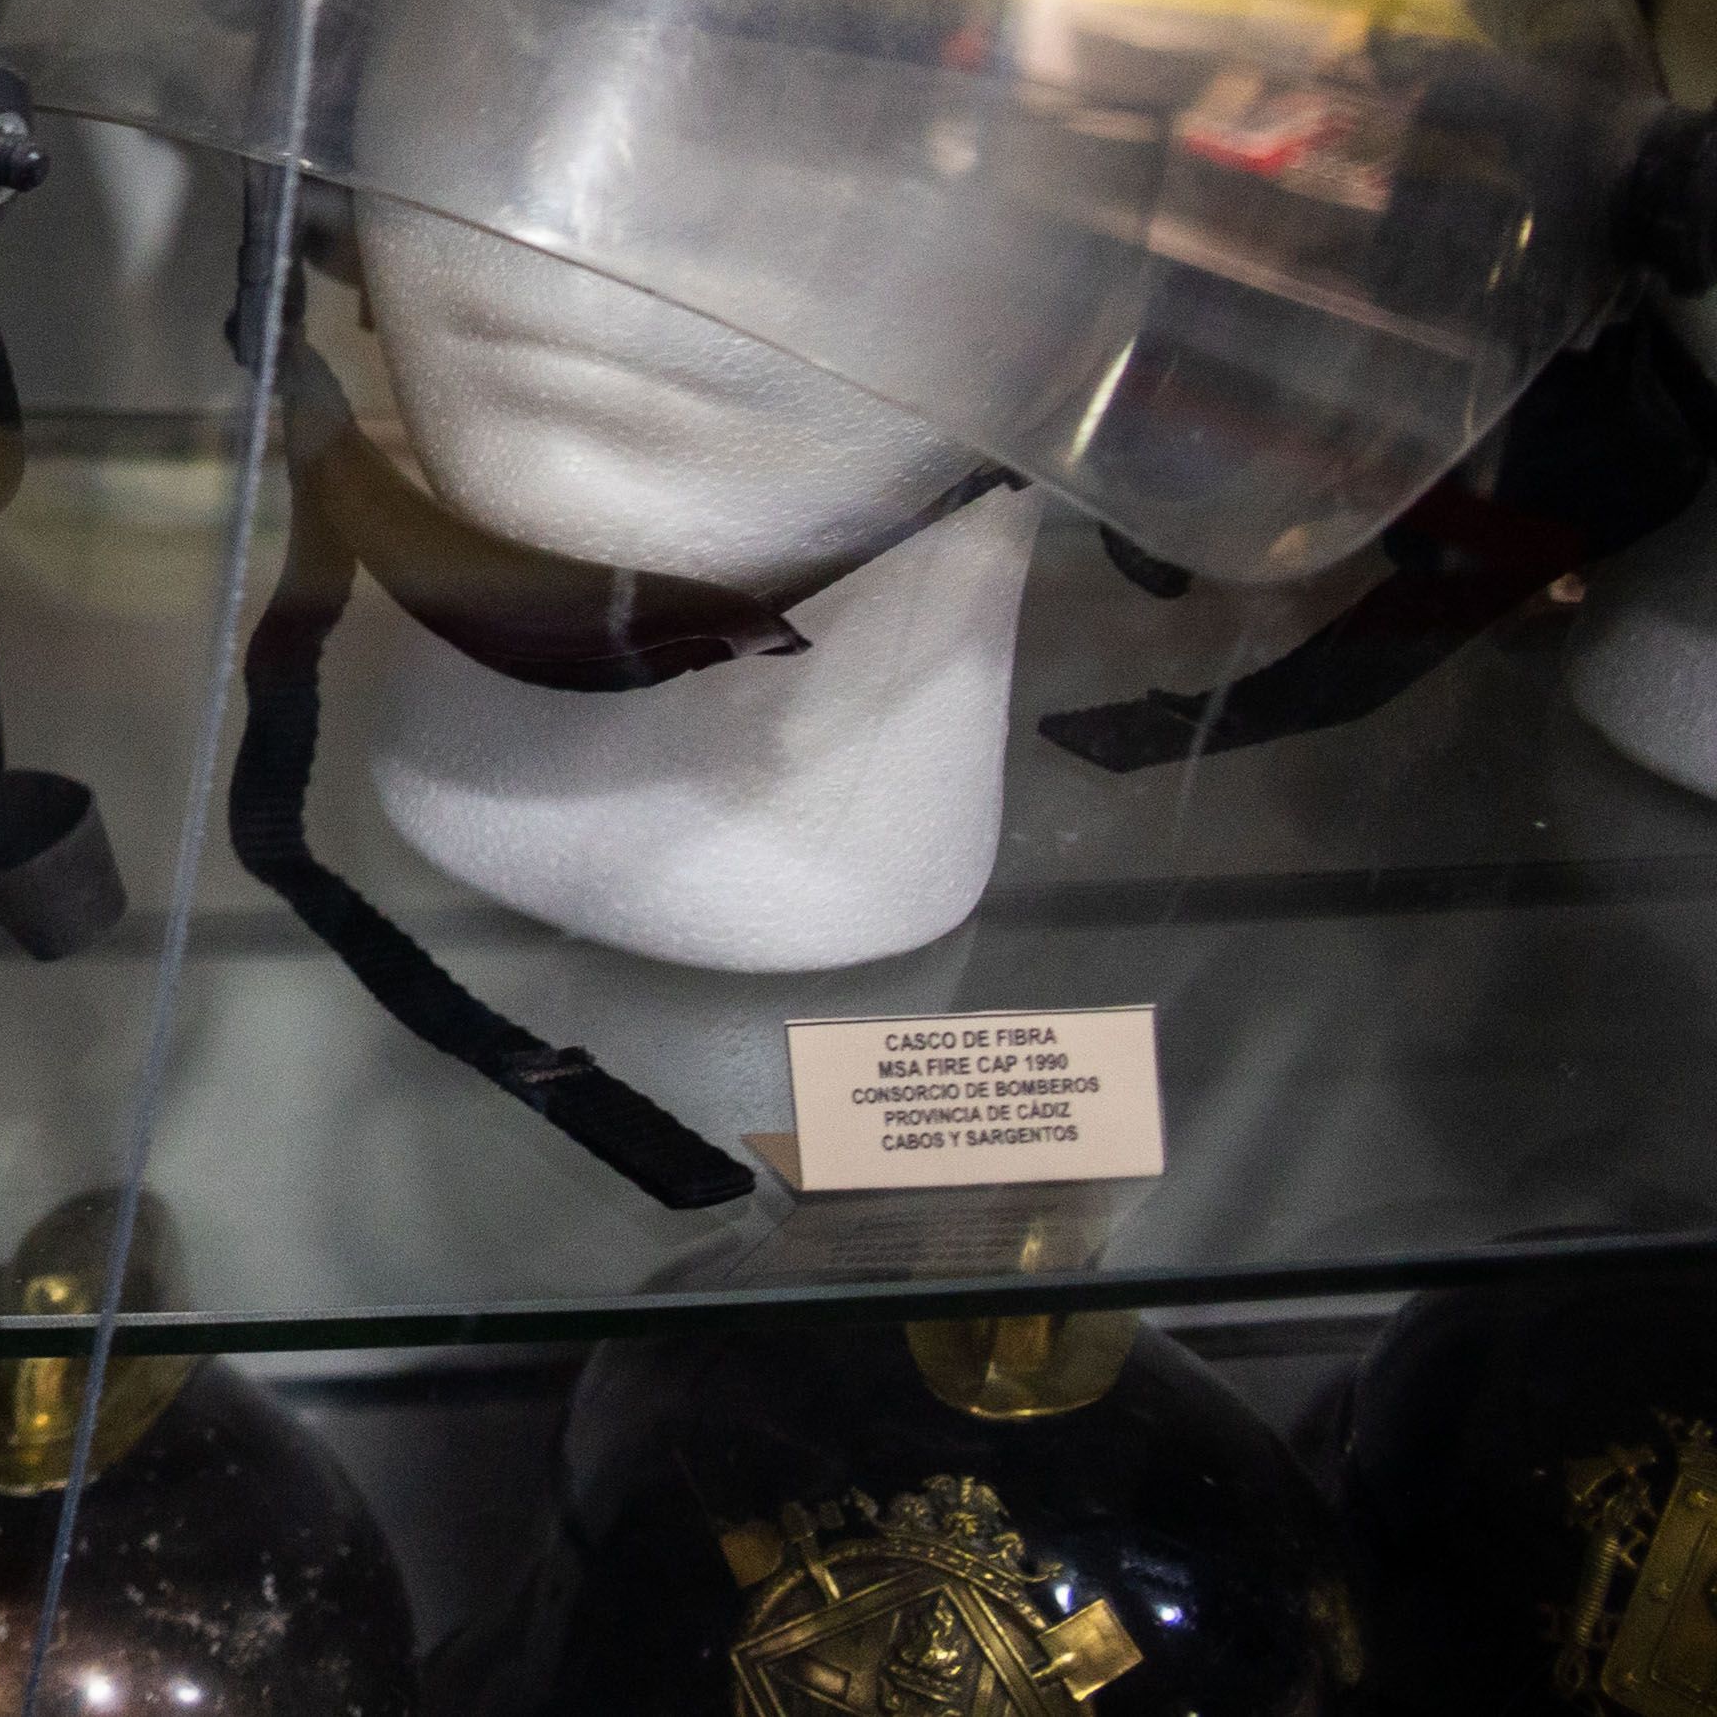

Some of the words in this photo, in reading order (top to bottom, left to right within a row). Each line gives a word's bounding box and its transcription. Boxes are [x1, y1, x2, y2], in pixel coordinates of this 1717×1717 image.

[884, 1032, 958, 1052] CASCO
[961, 1030, 991, 1049] DE
[995, 1028, 1058, 1046] FIBRA
[876, 1060, 924, 1078] MSA
[925, 1057, 972, 1075] FIRE
[975, 1055, 1019, 1073] CAP
[1023, 1053, 1070, 1071] 1990
[850, 1084, 962, 1104] CONSORCIO
[964, 1082, 990, 1099] DE
[993, 1077, 1101, 1097] BOMBEROS
[883, 1107, 984, 1125] PROVINCIA
[985, 1105, 1012, 1121] DE
[1015, 1099, 1072, 1120] CÁDIZ
[880, 1132, 946, 1151] CABOS
[948, 1132, 962, 1146] Y
[964, 1125, 1080, 1146] SARGENTOS
